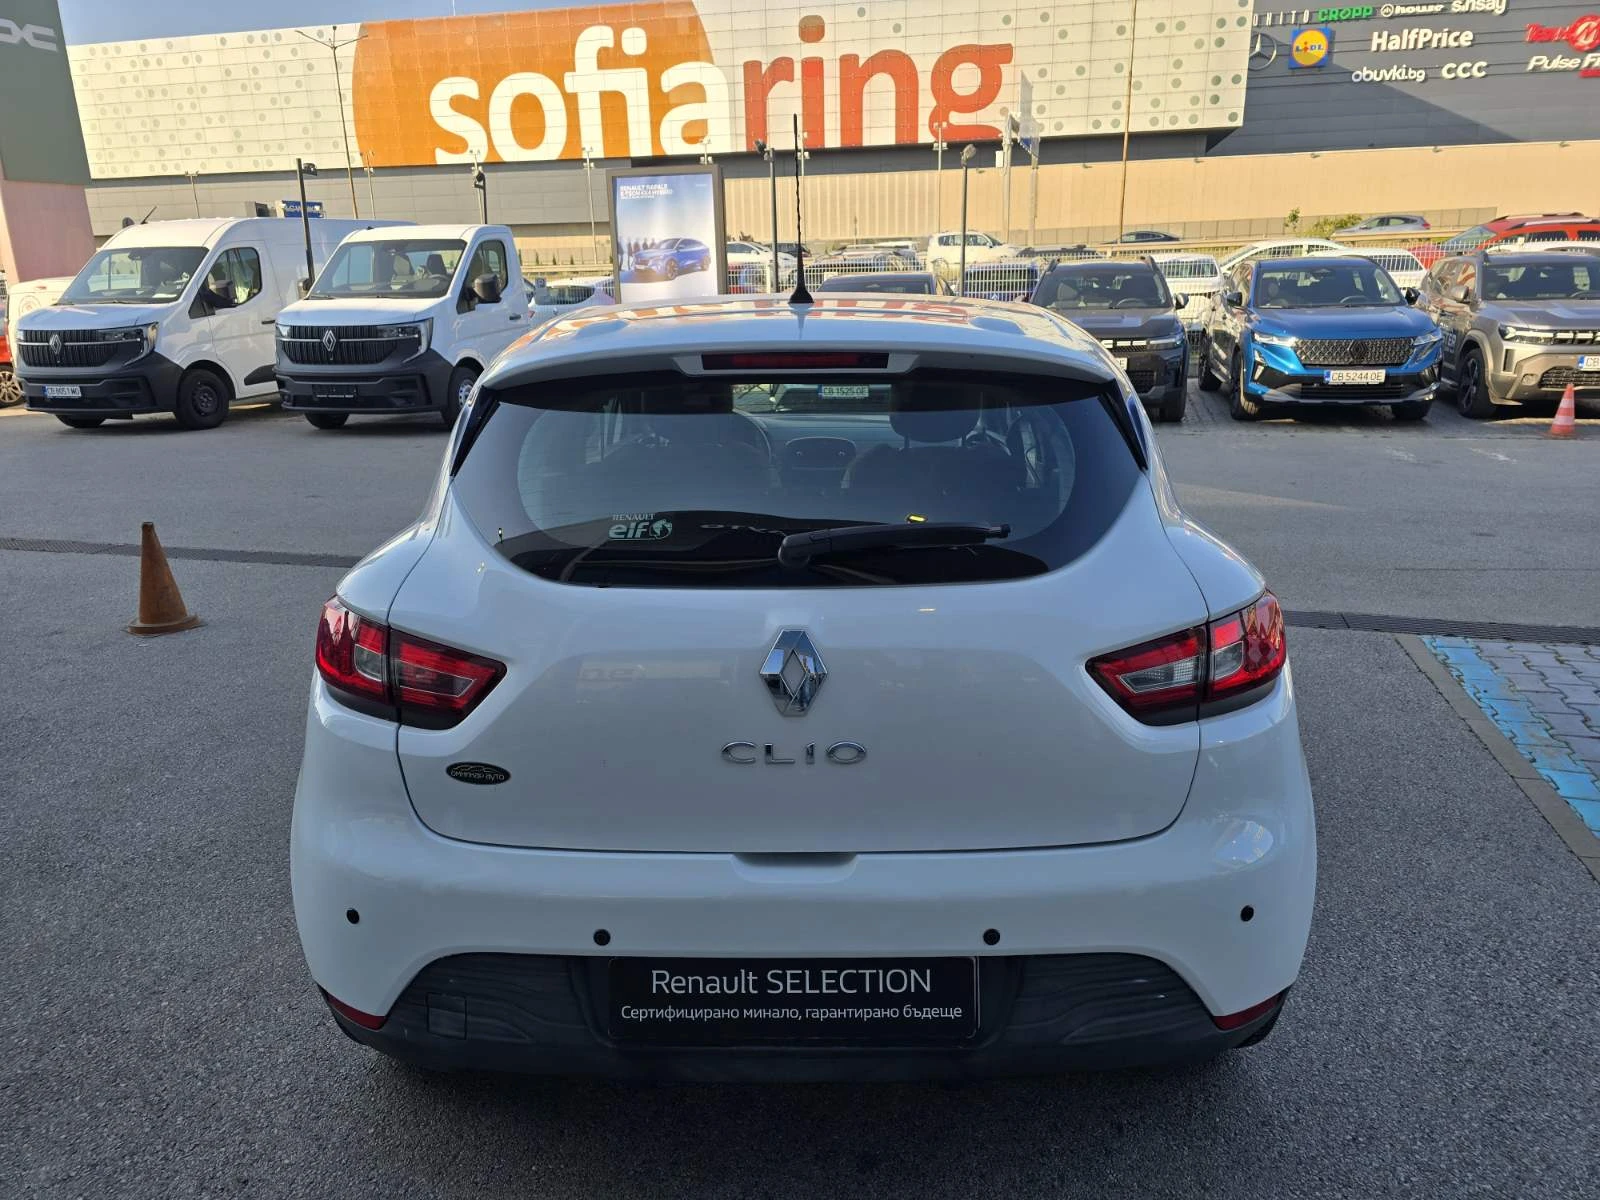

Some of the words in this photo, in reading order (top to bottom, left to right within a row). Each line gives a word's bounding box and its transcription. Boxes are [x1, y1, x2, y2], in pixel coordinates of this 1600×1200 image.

[1253, 9, 1310, 27] OHITO
[1317, 6, 1373, 22] CROPP
[1371, 27, 1474, 52] HalfPrice
[1527, 55, 1581, 72] Pulse
[1352, 64, 1426, 82] obuvki.bg
[1345, 371, 1369, 381] 5244
[612, 513, 656, 521] RENAULT
[608, 521, 650, 539] elf
[721, 740, 867, 765] CLIO
[651, 969, 758, 994] Renault
[767, 969, 931, 993] SELECTION
[621, 1005, 740, 1022] Сертифицирано
[743, 1008, 802, 1021] минало,
[805, 1007, 900, 1022] гарантирано
[902, 1004, 963, 1020] бъдеще
